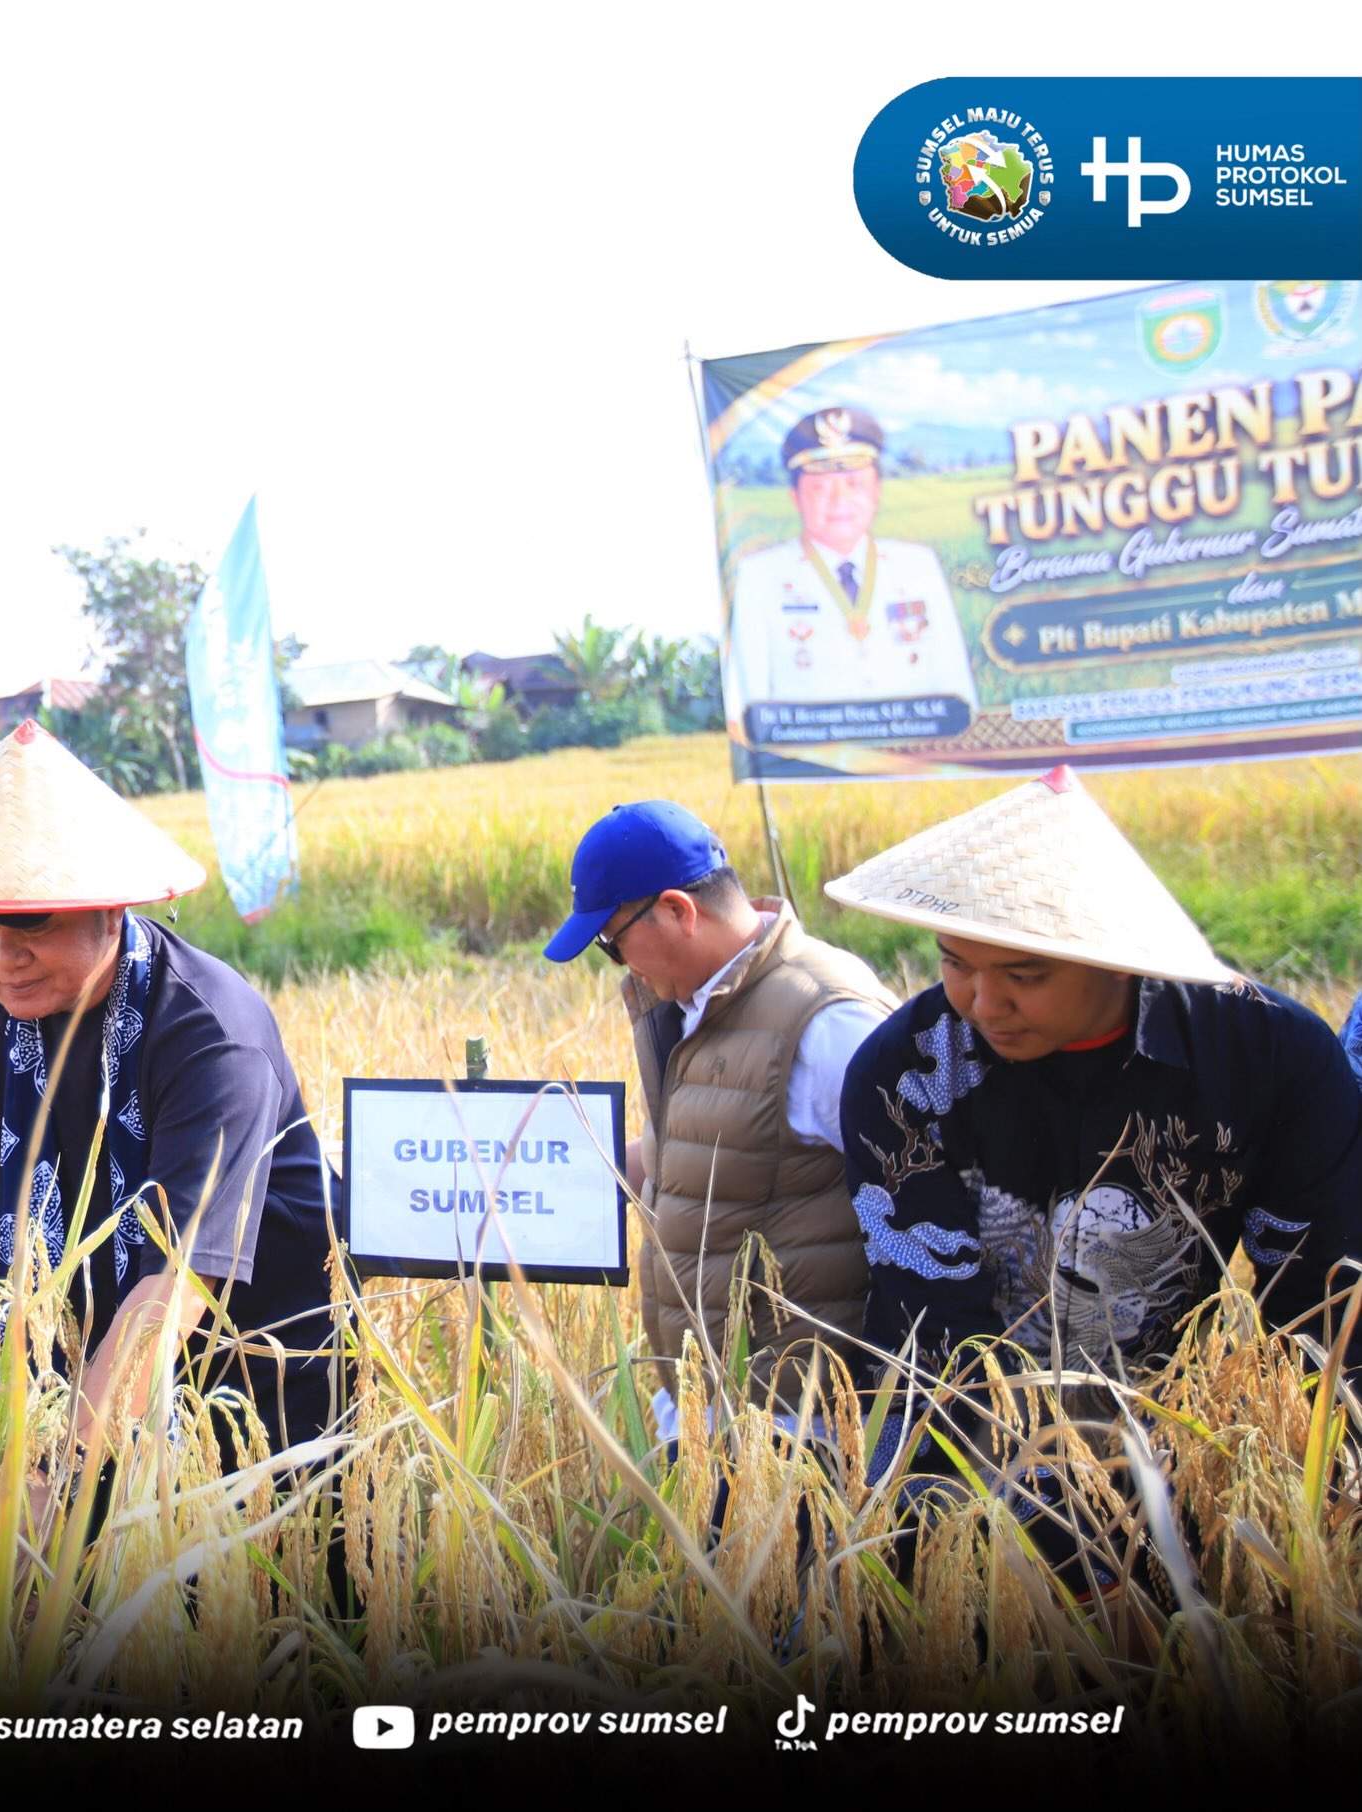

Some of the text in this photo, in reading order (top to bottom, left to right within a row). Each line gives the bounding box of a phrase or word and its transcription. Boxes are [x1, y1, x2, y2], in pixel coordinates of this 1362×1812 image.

[1011, 380, 1273, 484] PANEN
[975, 436, 1362, 546] TUNGGU TU
[989, 545, 1114, 593] Bersama
[1118, 526, 1257, 577] Gubernur
[1227, 570, 1286, 605] dan
[1083, 612, 1173, 654] Bupati
[1179, 600, 1329, 639] Kabupaten
[394, 1139, 571, 1164] GUBENUR
[409, 1189, 555, 1215] SUMSEL
